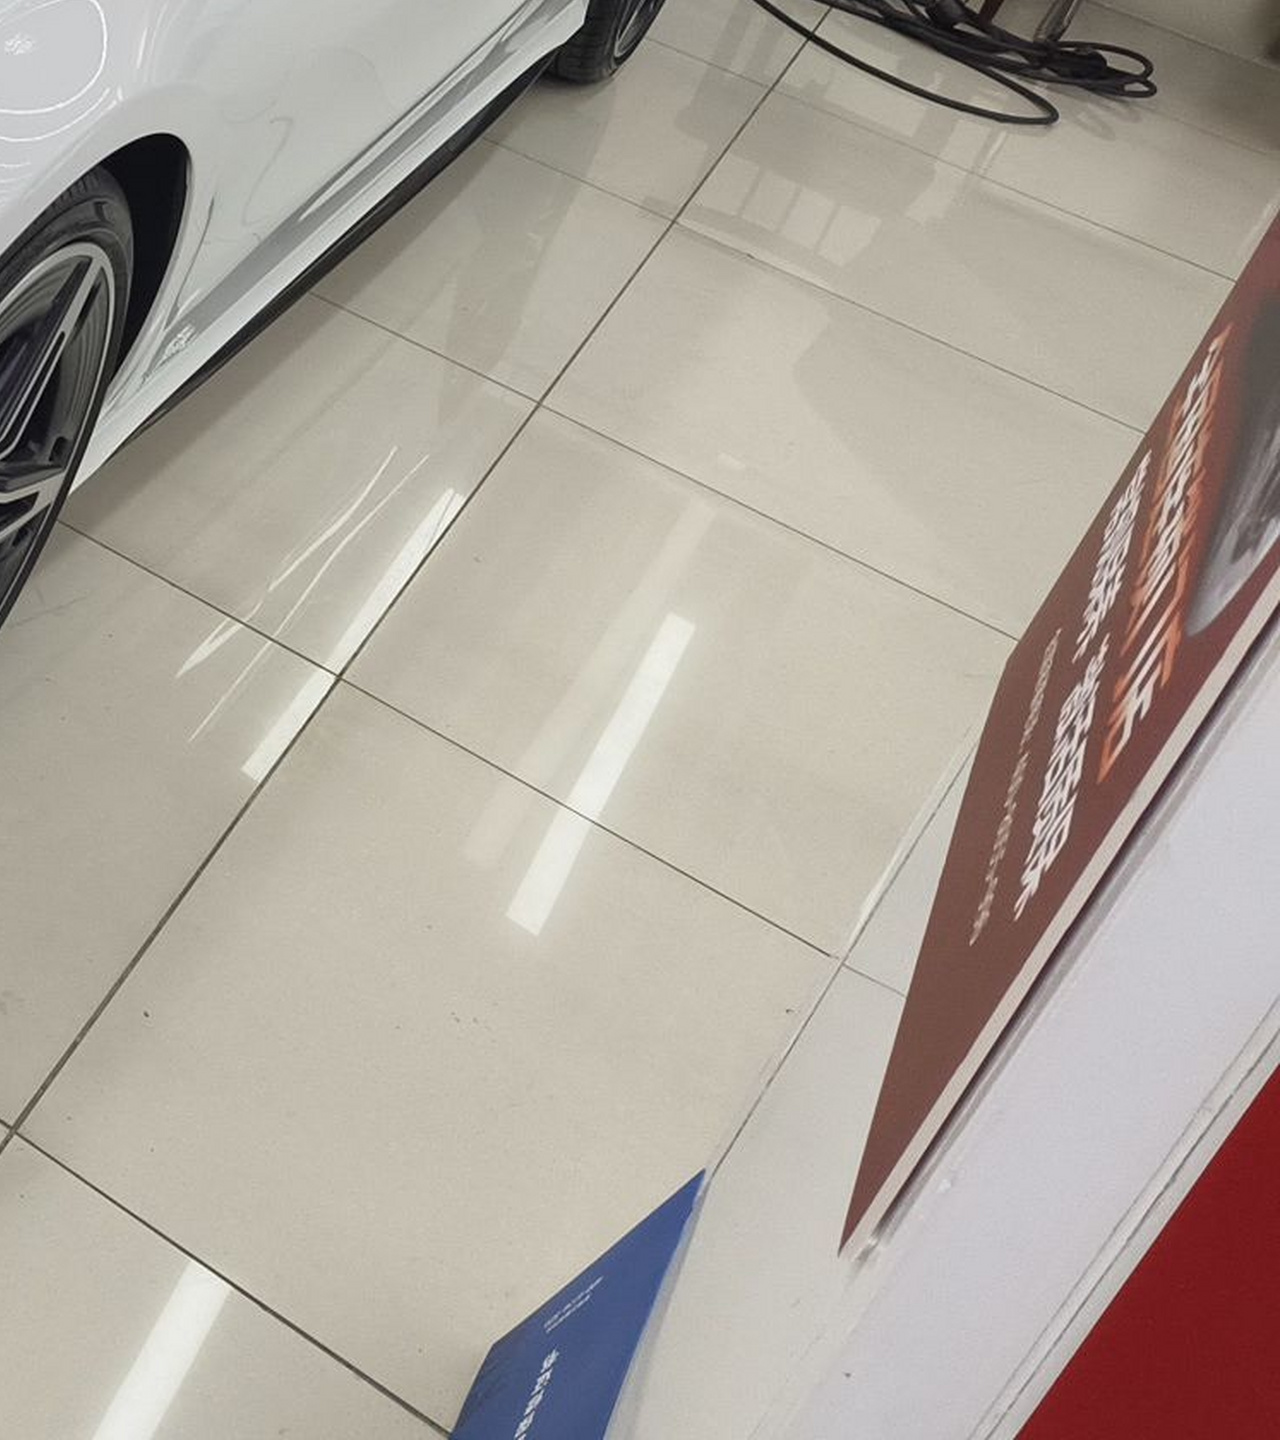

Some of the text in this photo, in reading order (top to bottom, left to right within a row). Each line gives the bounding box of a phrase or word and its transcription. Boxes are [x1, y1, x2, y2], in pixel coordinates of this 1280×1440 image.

[1097, 324, 1232, 783] 全国连锁门店
[1013, 632, 1111, 922] 激活质保
